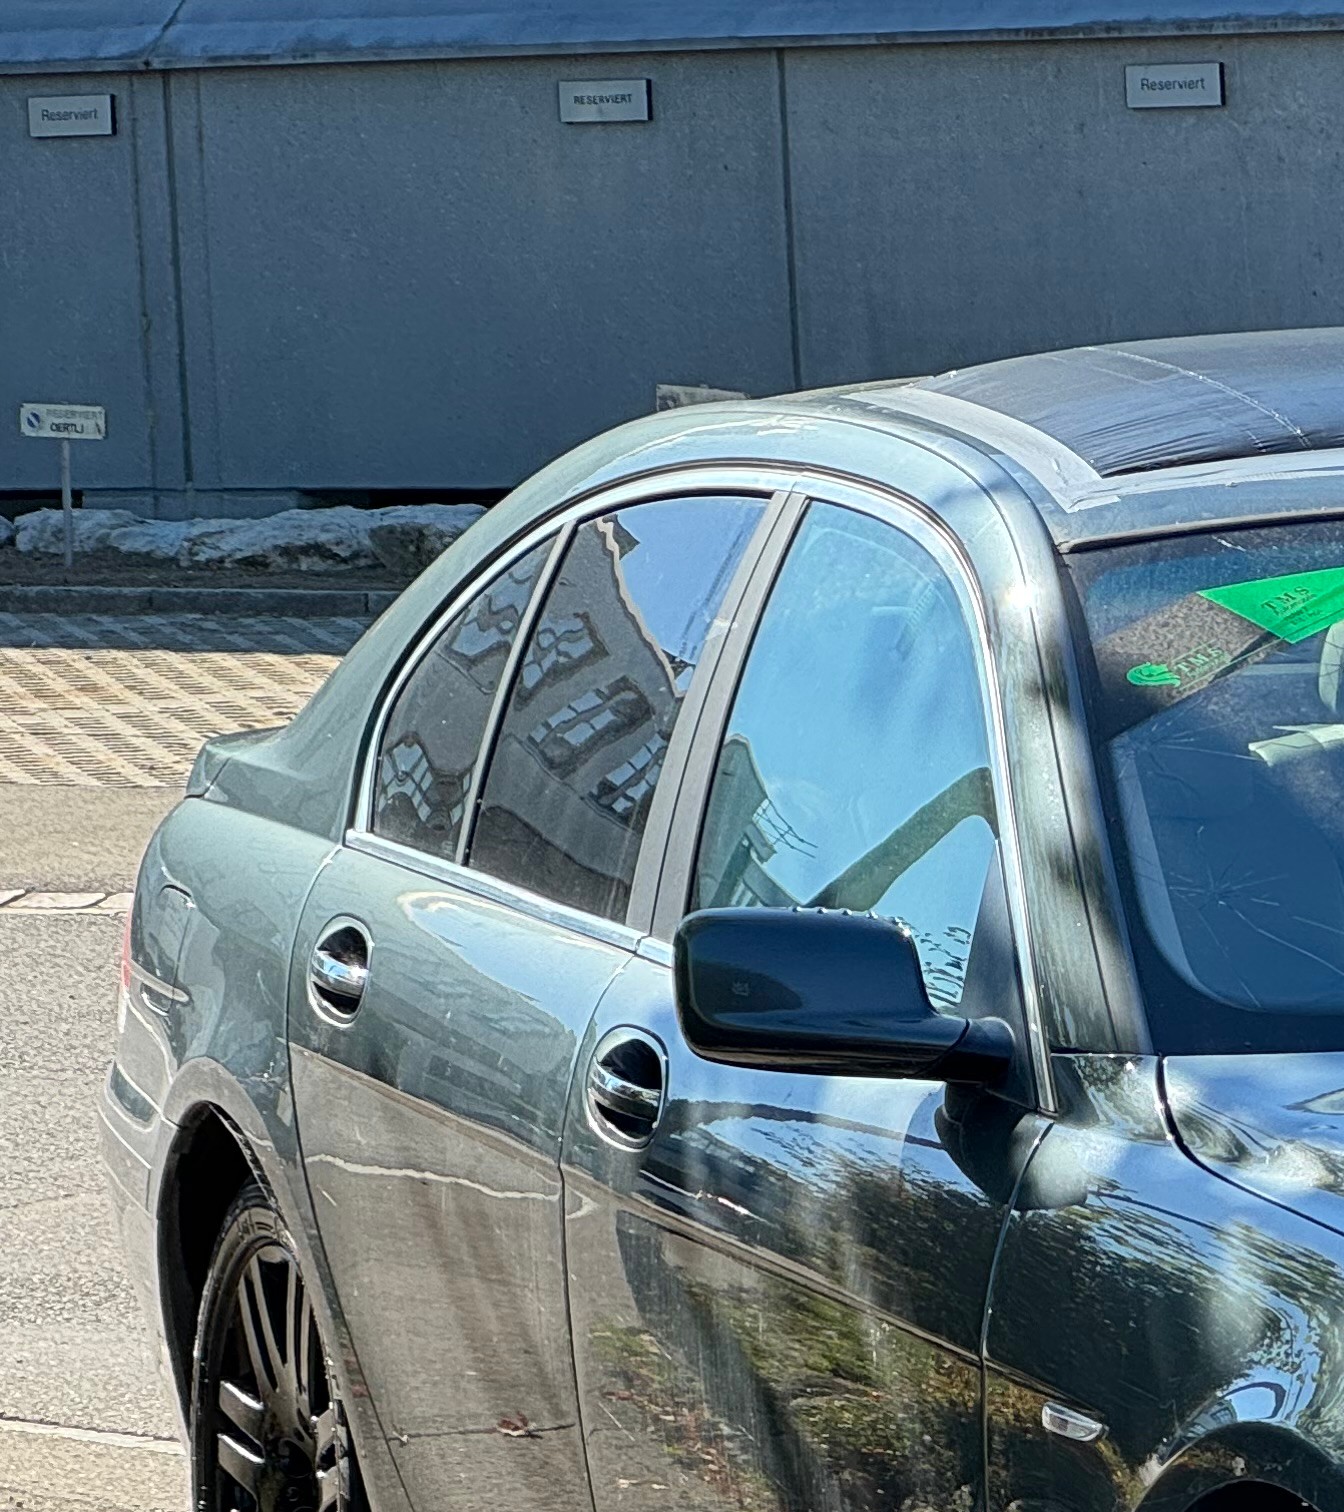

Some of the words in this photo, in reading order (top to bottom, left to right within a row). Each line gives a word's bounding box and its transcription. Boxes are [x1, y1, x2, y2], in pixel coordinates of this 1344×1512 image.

[1140, 78, 1206, 91] Reserviert
[573, 93, 632, 105] RESERVIERT
[41, 108, 98, 121] Reserviert
